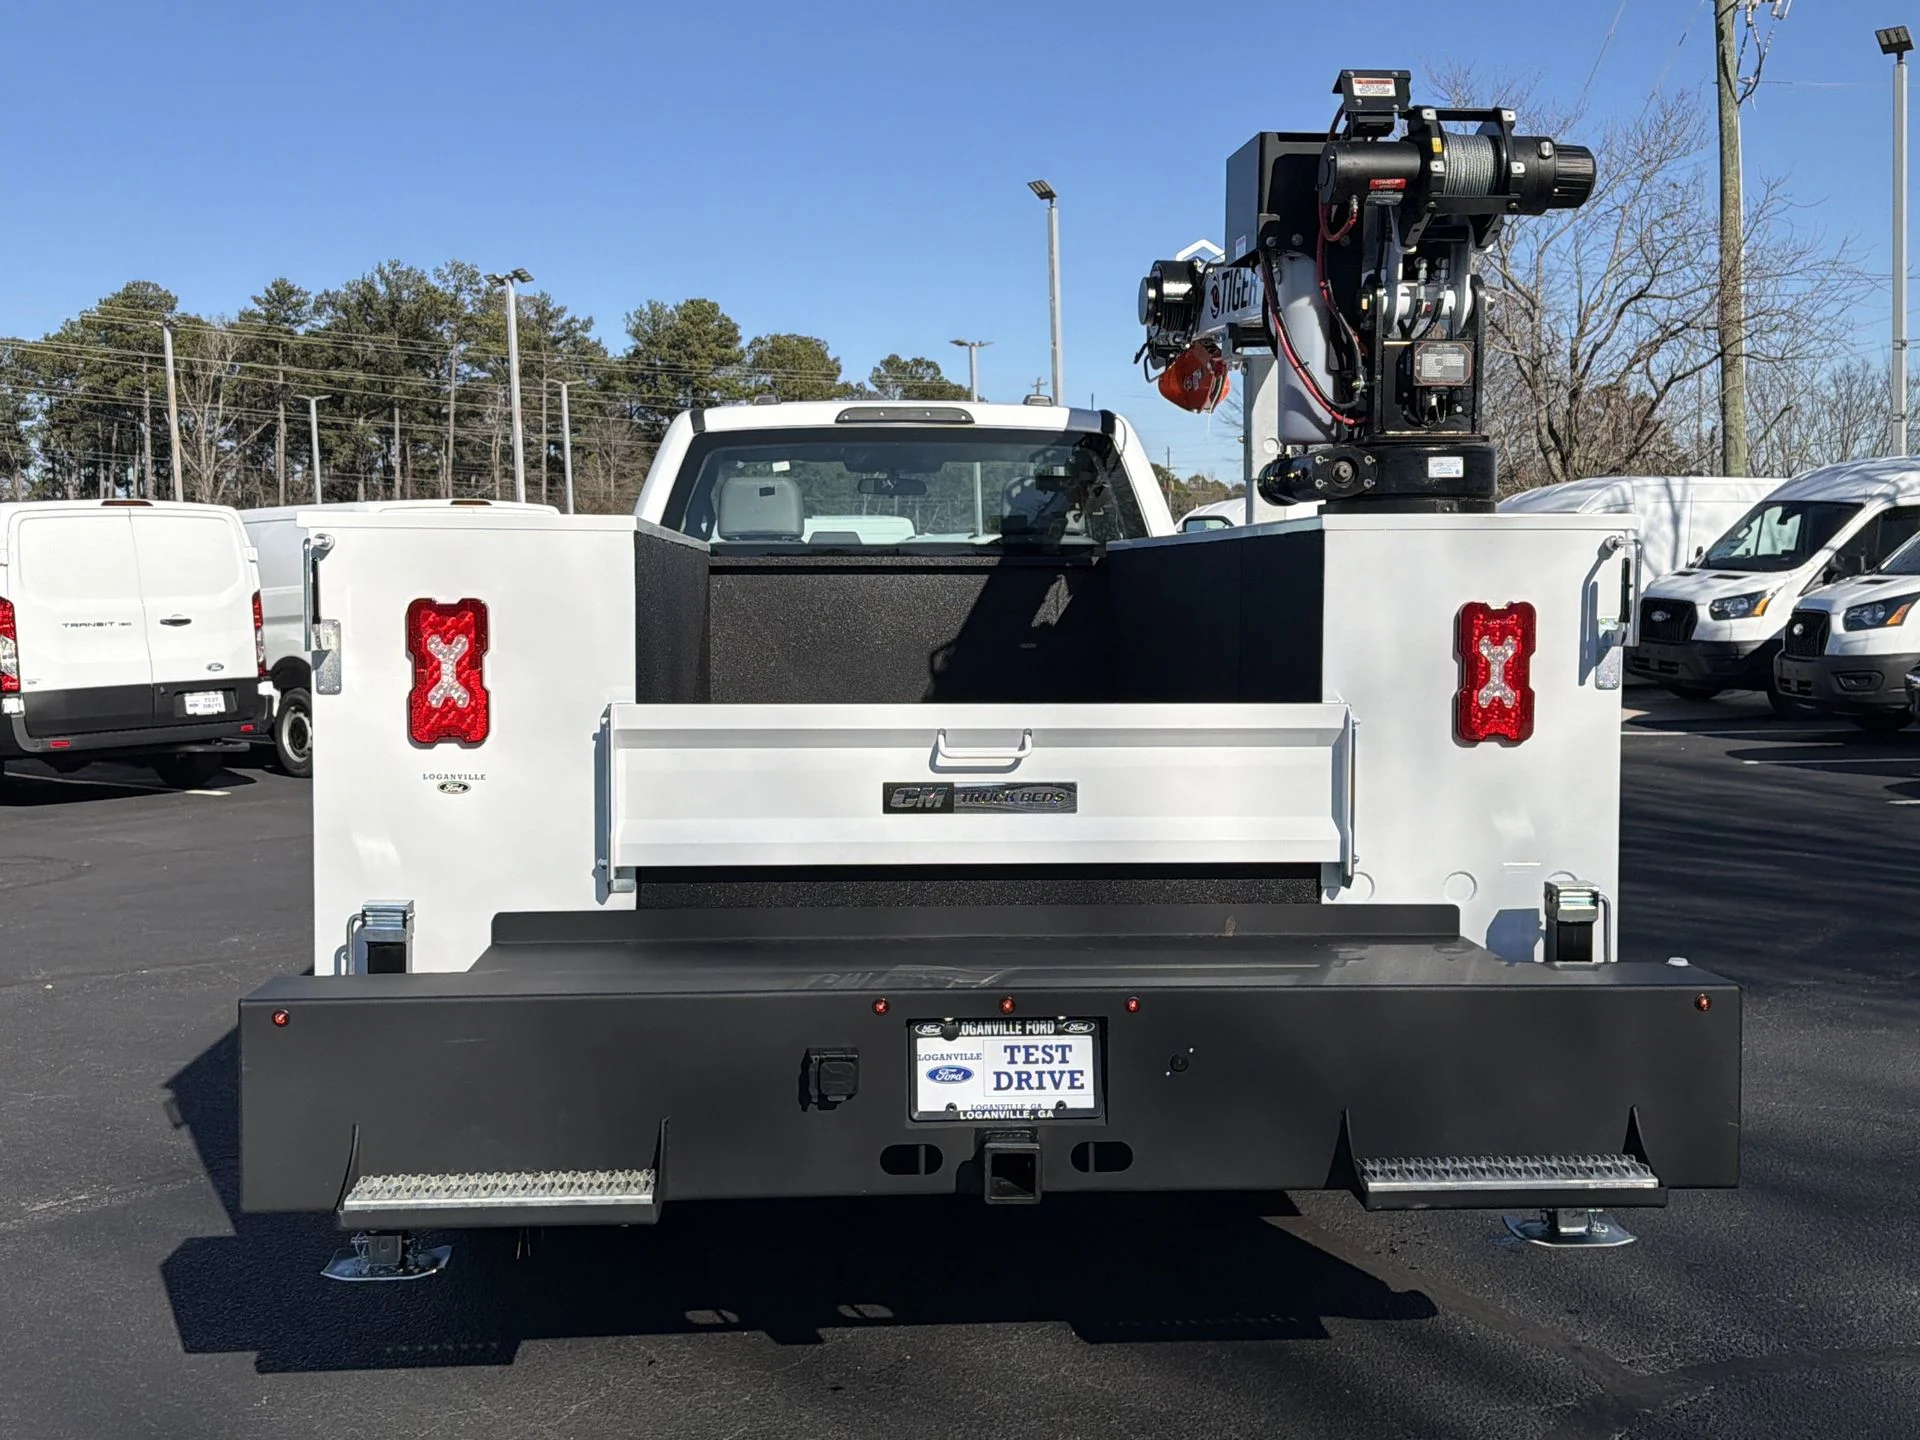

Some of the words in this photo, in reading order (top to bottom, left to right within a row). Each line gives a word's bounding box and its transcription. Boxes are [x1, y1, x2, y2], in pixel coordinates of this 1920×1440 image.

[1221, 266, 1258, 314] TIGER
[890, 787, 948, 808] CM
[961, 791, 1016, 803] TRUCK
[1019, 792, 1065, 802] BEDS
[921, 1025, 941, 1033] Ford
[1026, 1020, 1055, 1034] FORD
[1069, 1023, 1088, 1031] Ford
[918, 1053, 982, 1061] LOGANVILLE
[1003, 1044, 1073, 1065] TEST
[935, 1068, 965, 1081] Ford
[993, 1070, 1085, 1091] DRIVE
[960, 1110, 1034, 1120] LOGANVILLE,
[1038, 1110, 1054, 1118] GA
